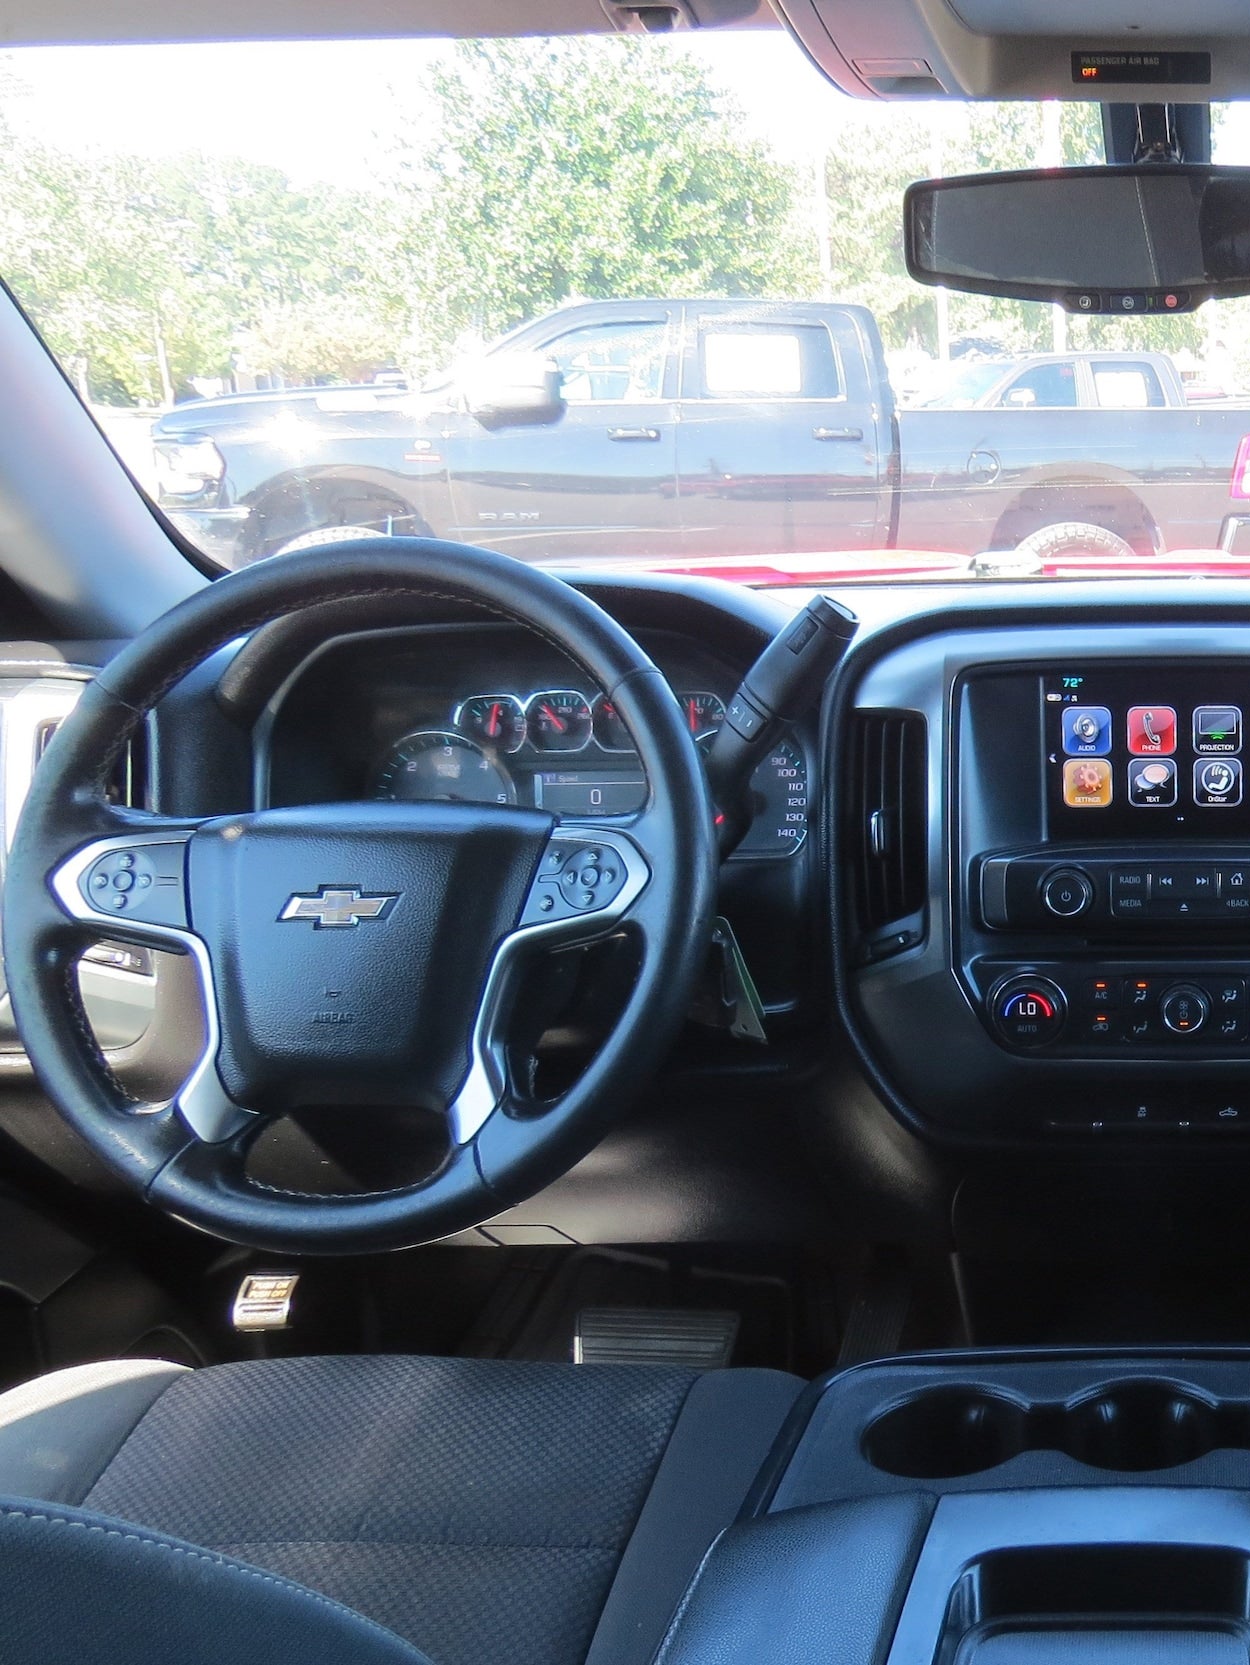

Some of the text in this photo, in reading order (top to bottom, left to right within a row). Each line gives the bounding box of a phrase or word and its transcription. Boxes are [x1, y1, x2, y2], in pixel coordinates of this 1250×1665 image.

[1080, 56, 1160, 65] PASSENGER AIR BAG
[1082, 68, 1097, 77] OFF
[443, 746, 453, 757] 3
[1077, 744, 1096, 752] AUDIO
[479, 760, 489, 771] 4
[771, 757, 787, 766] 90
[407, 761, 417, 772] 2
[777, 768, 797, 777] 100
[788, 782, 804, 791] 110
[496, 793, 507, 804] 5
[590, 789, 602, 805] 0
[1207, 795, 1228, 803] OnStar
[787, 797, 807, 807] 120
[785, 813, 804, 822] 130
[777, 828, 797, 837] 140
[1119, 875, 1141, 885] RADIO
[1119, 900, 1142, 908] MEDIA
[1230, 900, 1250, 908] BACK
[1094, 991, 1108, 1000] A/C
[1019, 1001, 1037, 1016] LO
[1017, 1024, 1038, 1033] AUTO
